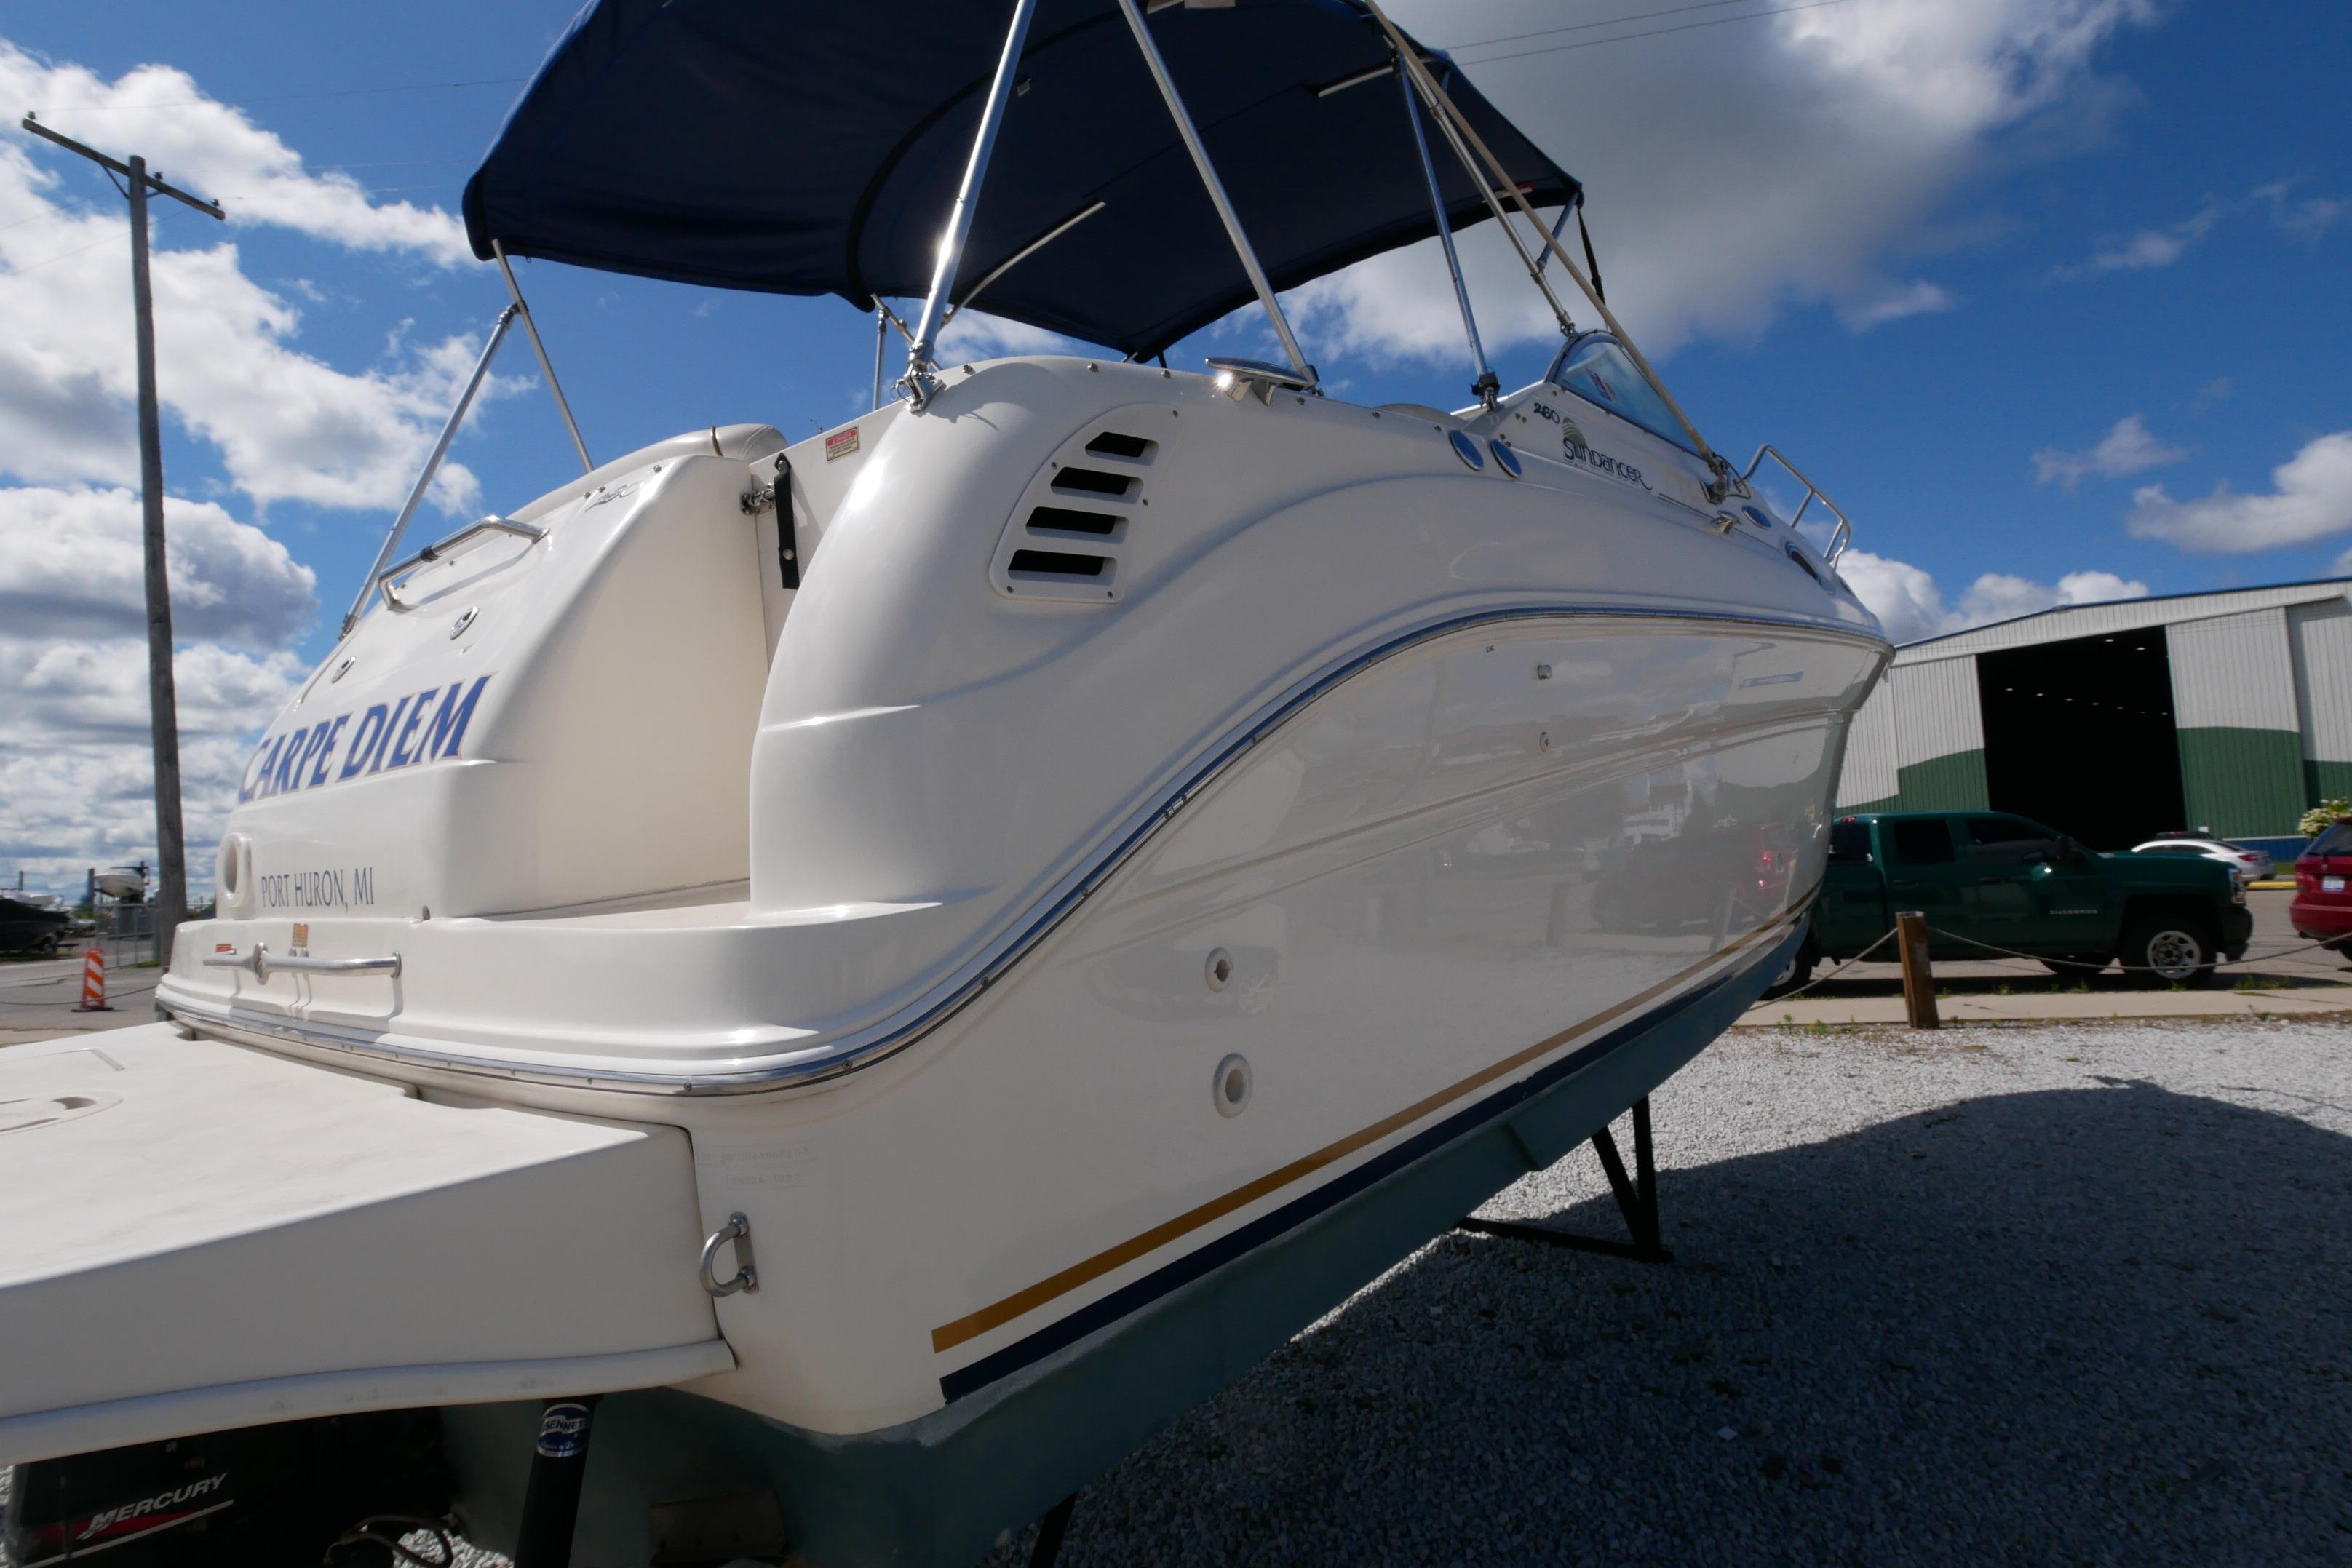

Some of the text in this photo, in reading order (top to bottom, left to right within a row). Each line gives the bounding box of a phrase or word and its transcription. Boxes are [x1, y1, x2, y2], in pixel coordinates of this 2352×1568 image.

[1533, 402, 1560, 424] 260
[238, 672, 498, 805] CARPE DIEM
[261, 867, 375, 912] PORT HURON, MI
[75, 1471, 228, 1540] MERCURY
